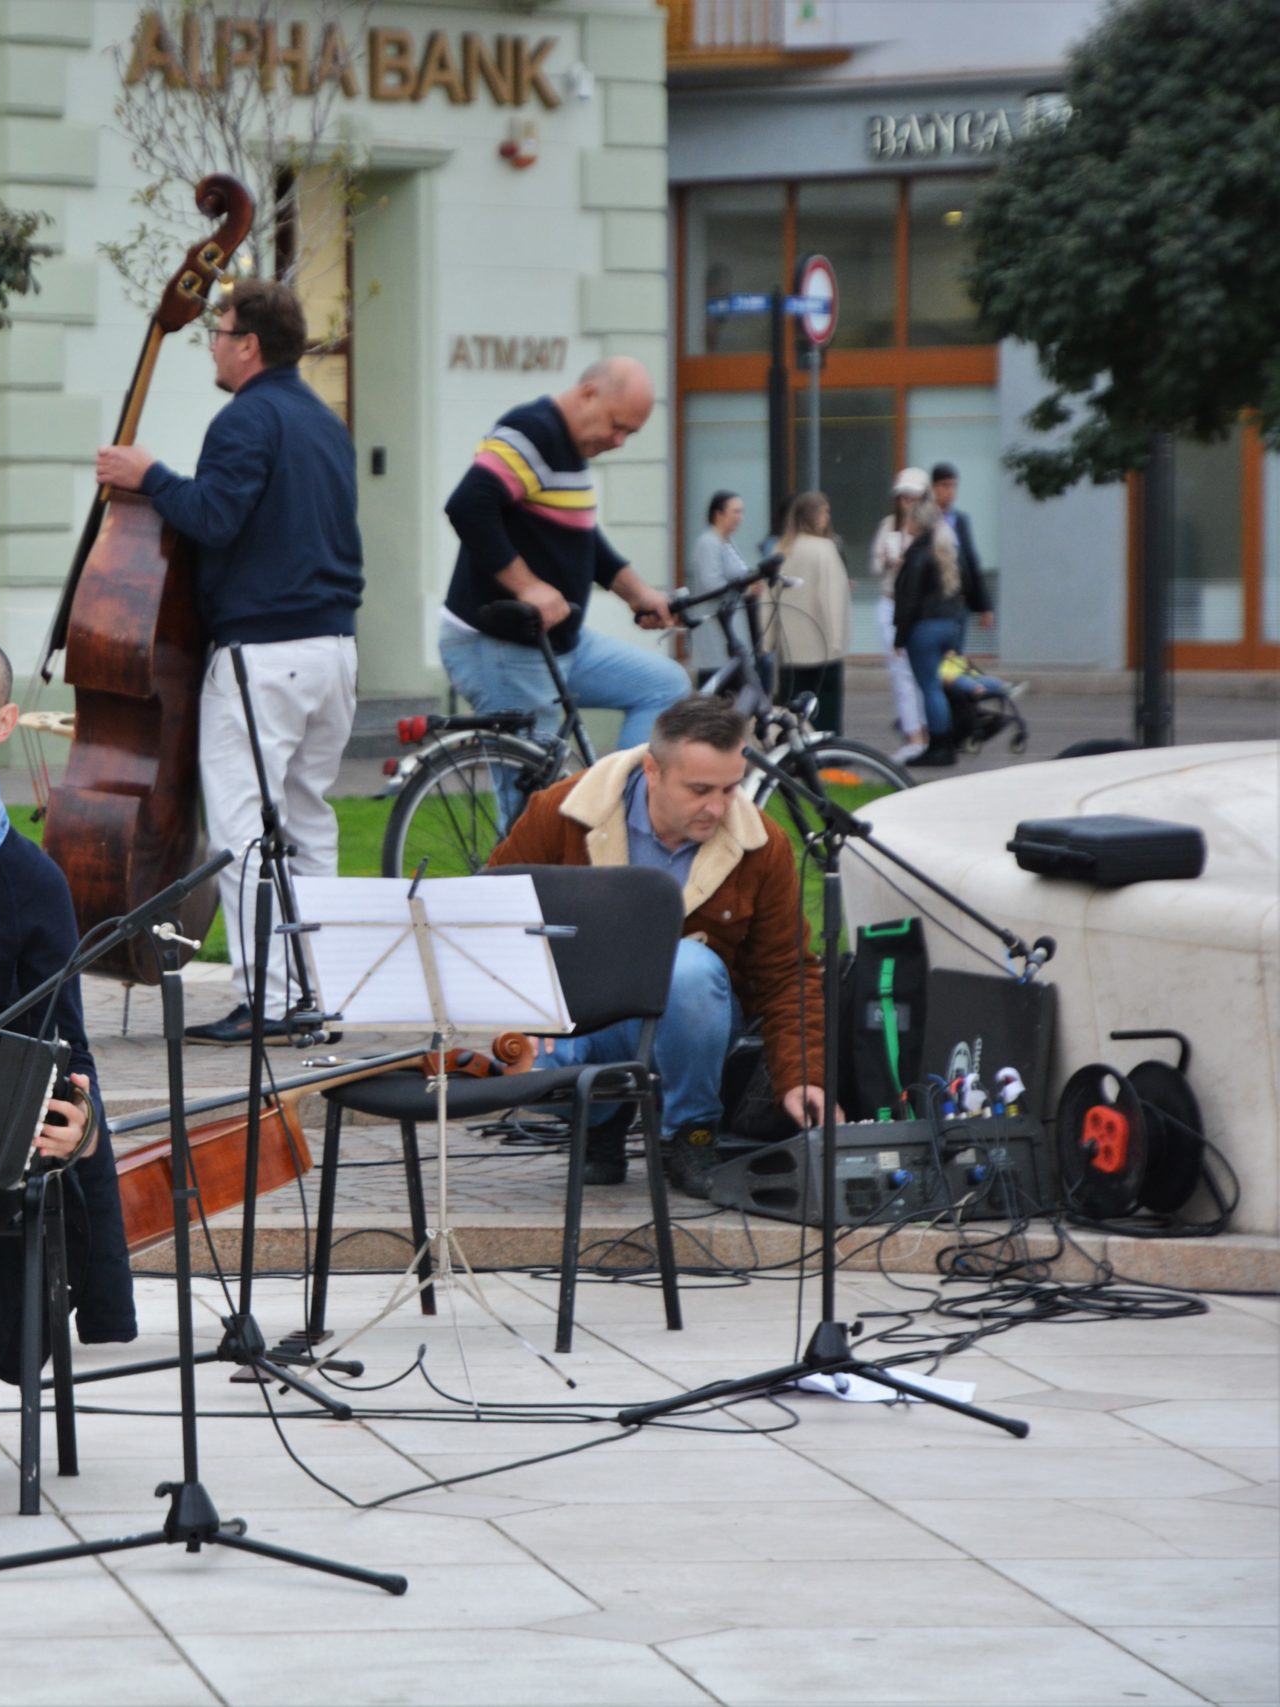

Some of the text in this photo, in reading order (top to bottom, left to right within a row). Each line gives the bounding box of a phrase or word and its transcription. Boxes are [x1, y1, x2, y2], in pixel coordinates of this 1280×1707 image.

[125, 10, 562, 110] ALPHA BANK
[869, 109, 1014, 158] BANCA
[448, 334, 518, 371] ATM
